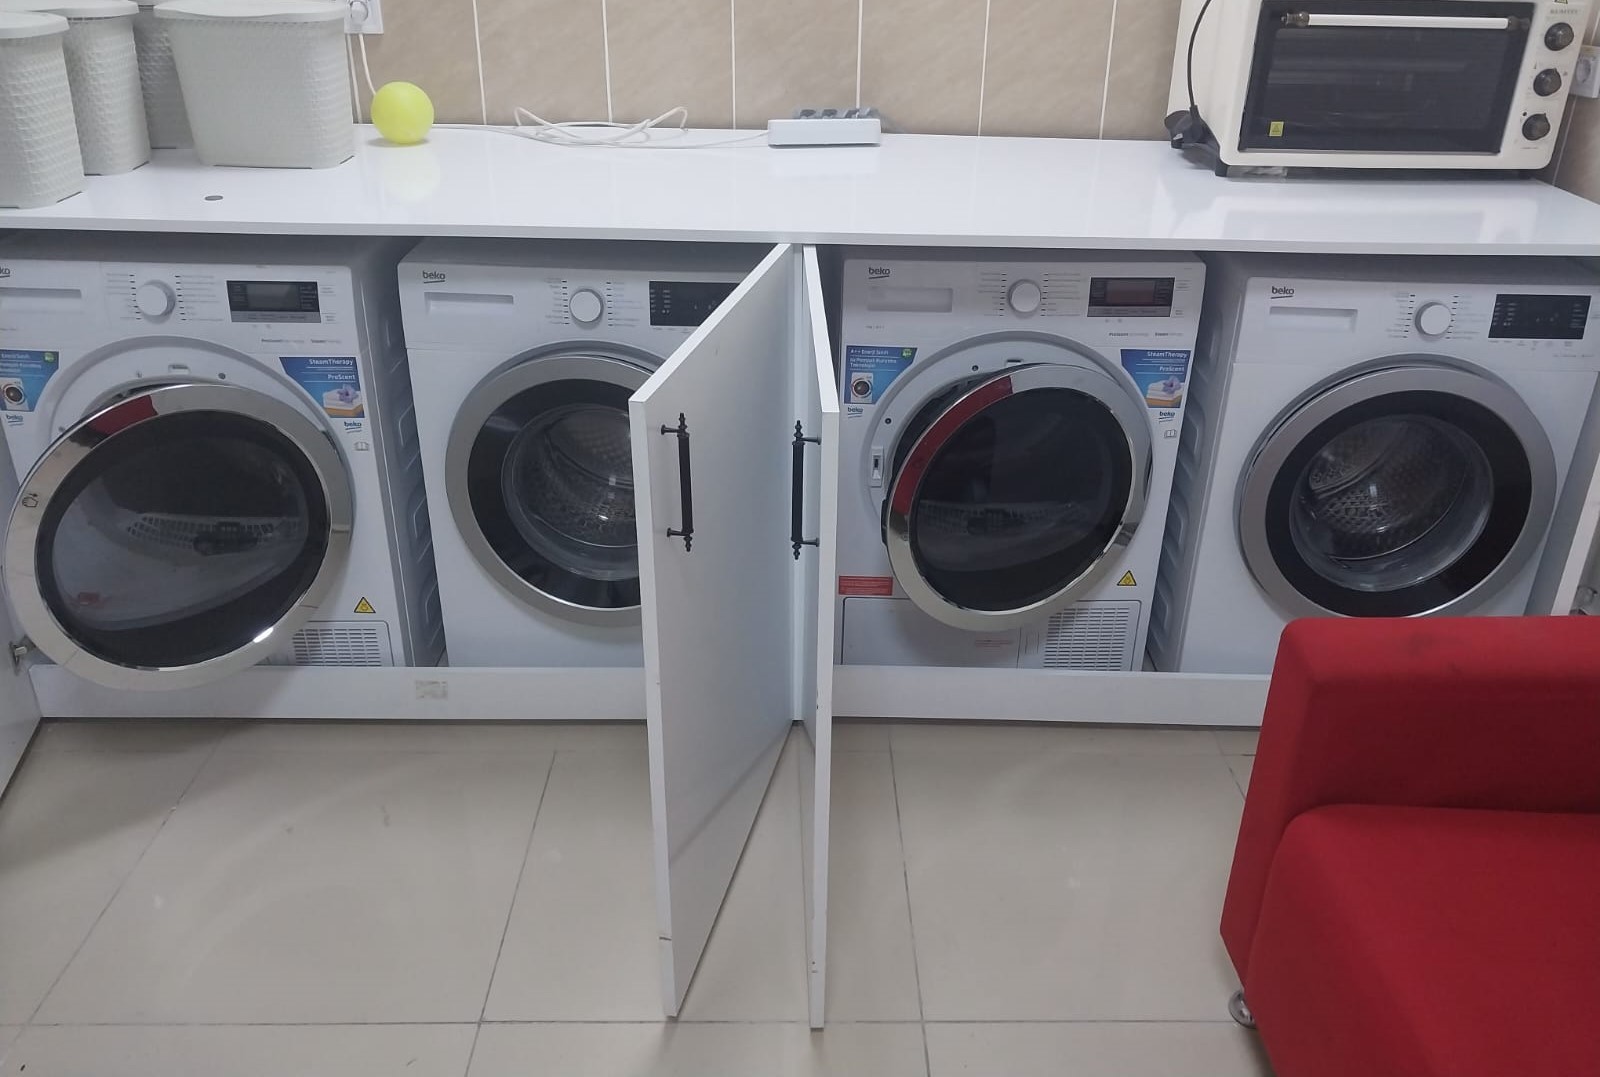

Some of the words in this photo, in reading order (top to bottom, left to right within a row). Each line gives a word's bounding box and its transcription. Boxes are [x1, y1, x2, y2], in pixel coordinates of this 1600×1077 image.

[422, 270, 446, 280] beko
[868, 266, 891, 275] beko
[1271, 285, 1295, 295] beko
